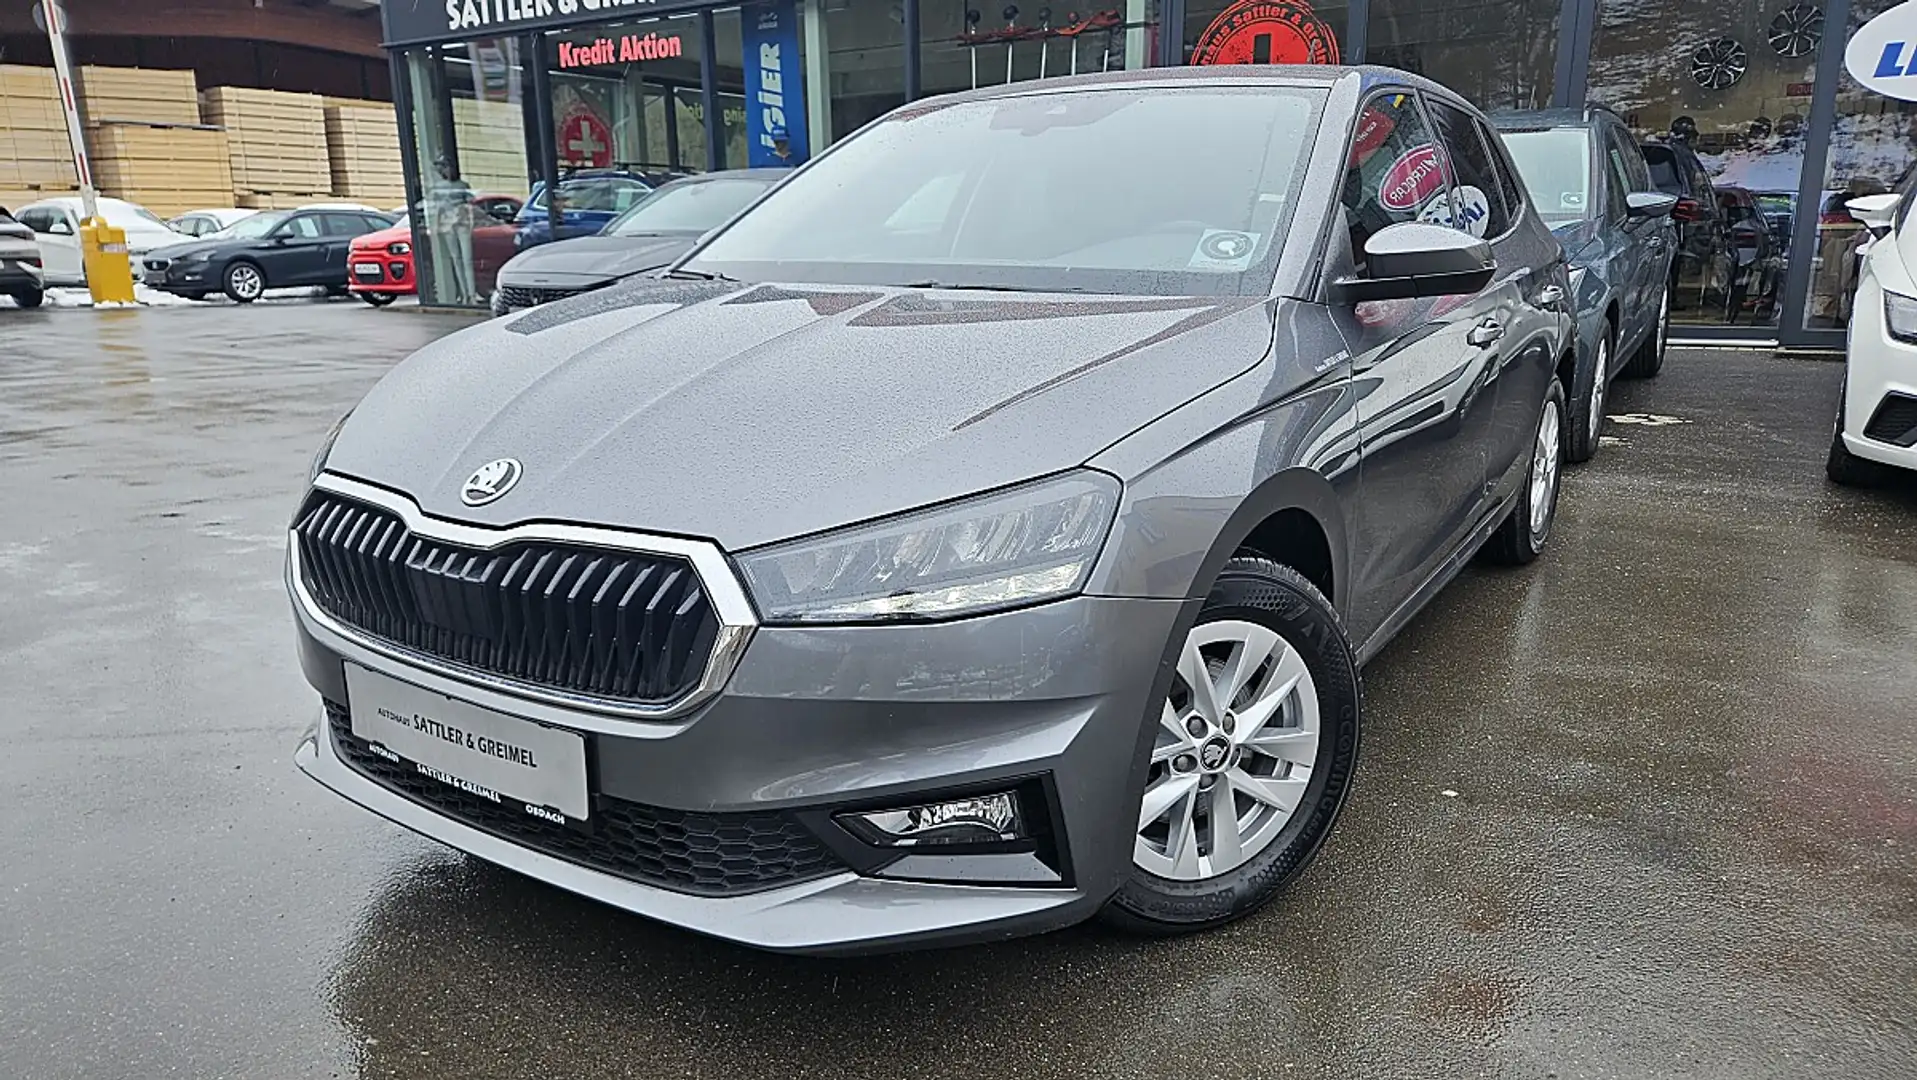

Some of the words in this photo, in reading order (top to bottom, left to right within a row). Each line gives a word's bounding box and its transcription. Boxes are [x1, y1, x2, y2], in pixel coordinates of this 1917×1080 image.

[559, 41, 616, 68] Kredit
[619, 32, 682, 61] Aktion
[377, 707, 411, 727] AUTOHAUS
[413, 714, 463, 746] SATTLER
[466, 732, 476, 750] &
[477, 736, 538, 768] GREIMEL
[416, 763, 452, 785] SATTLER
[461, 780, 502, 803] GREIMEL
[525, 803, 566, 825] OBDACH
